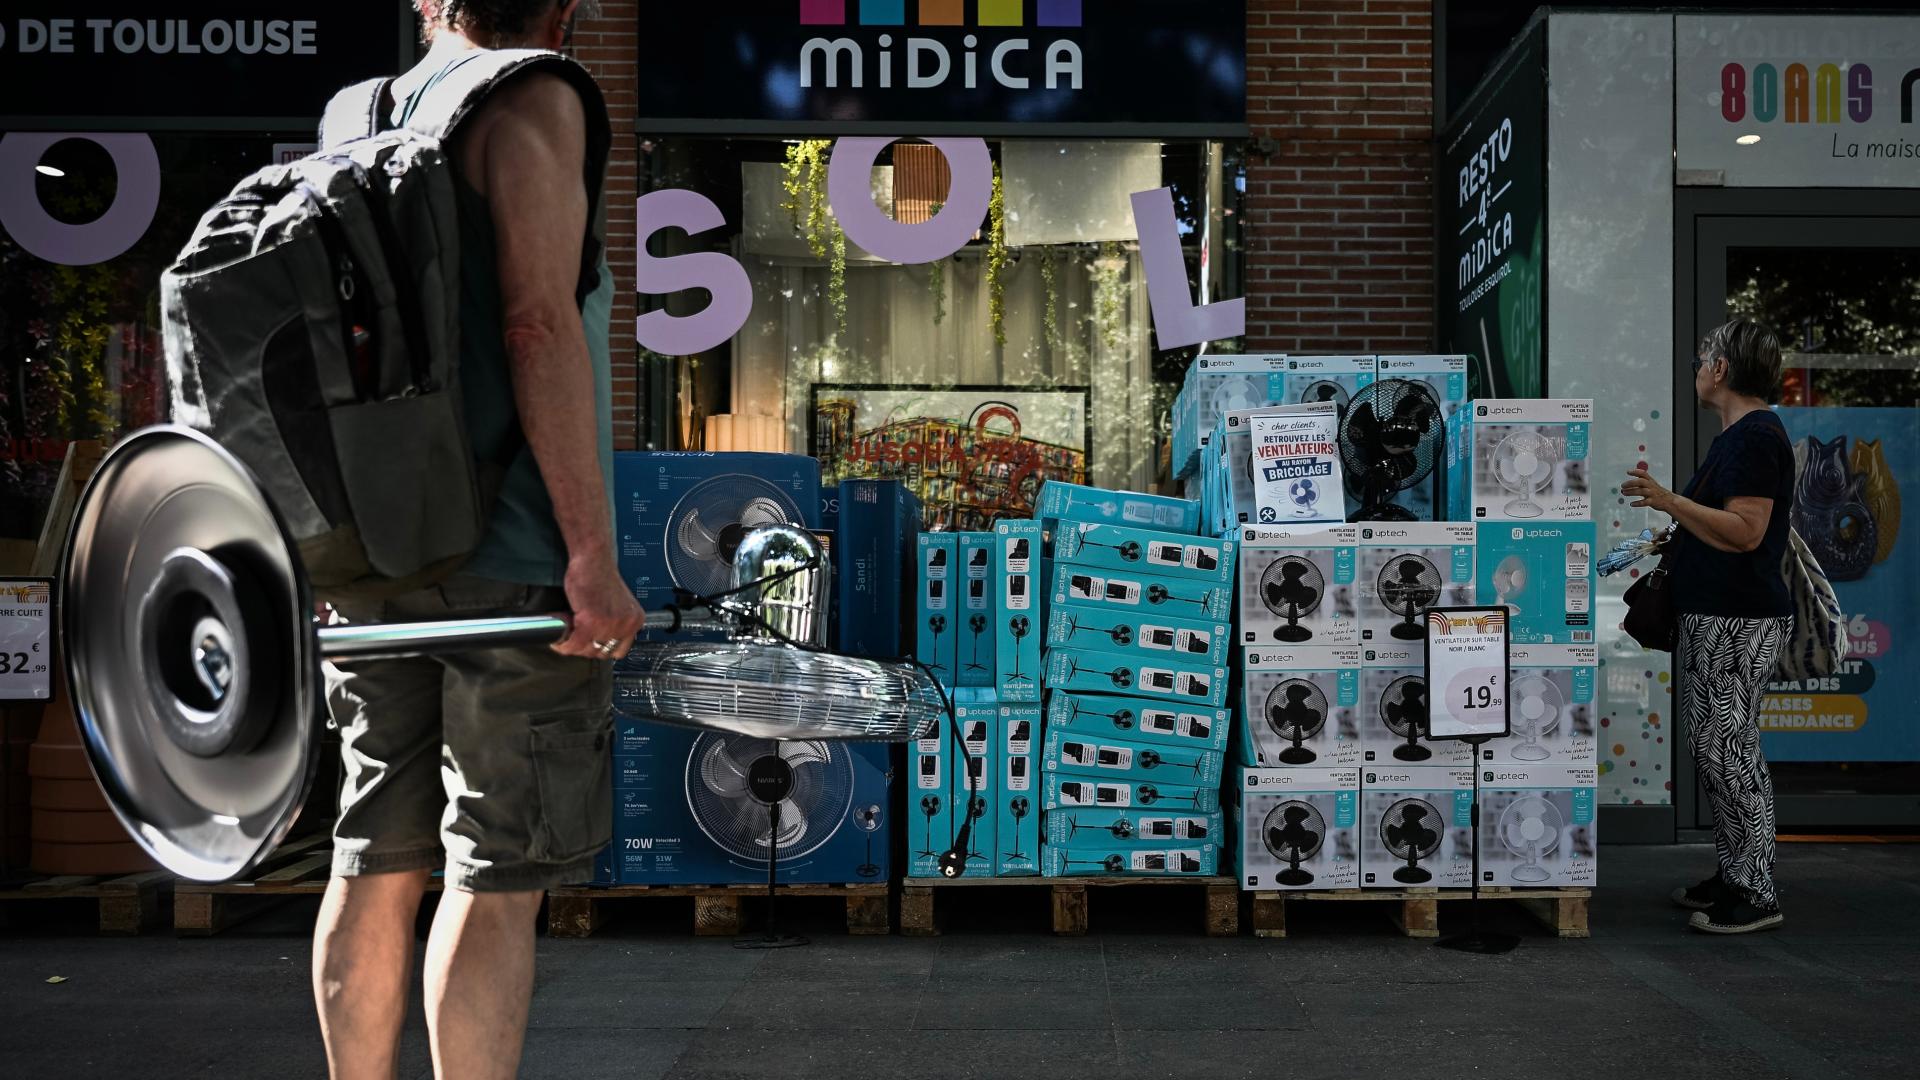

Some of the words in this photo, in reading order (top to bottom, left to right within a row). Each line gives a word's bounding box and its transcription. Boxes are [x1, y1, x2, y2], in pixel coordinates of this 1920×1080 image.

[19, 20, 75, 53] DE
[86, 19, 318, 55] TOULOUSE
[800, 35, 1083, 90] miDiCA
[1832, 133, 1858, 158] La
[1459, 118, 1512, 208] RESTO
[1460, 282, 1484, 312] TOULOUSE
[1484, 260, 1512, 293] ESQUIROL
[1210, 360, 1234, 368] uptech
[1298, 361, 1324, 369] uptech
[1390, 360, 1415, 368] uptech
[1490, 406, 1522, 415] uptech
[1272, 422, 1288, 431] cher
[1264, 434, 1310, 443] RETROUVEZ
[1312, 434, 1326, 442] LES
[1257, 442, 1334, 458] VENTILATEURS
[1291, 458, 1312, 466] RAYON
[1269, 464, 1328, 480] BRICOLAGE
[1527, 529, 1562, 539] uptech
[1222, 552, 1230, 580] uptech
[856, 558, 866, 592] Sandi
[1434, 637, 1470, 645] VENTILATEUR
[32, 642, 40, 652] €
[1490, 675, 1496, 685] €
[1806, 678, 1840, 690] DES
[1760, 698, 1813, 710] VASES
[1758, 714, 1854, 727] TENDANCE
[625, 839, 652, 849] 70W
